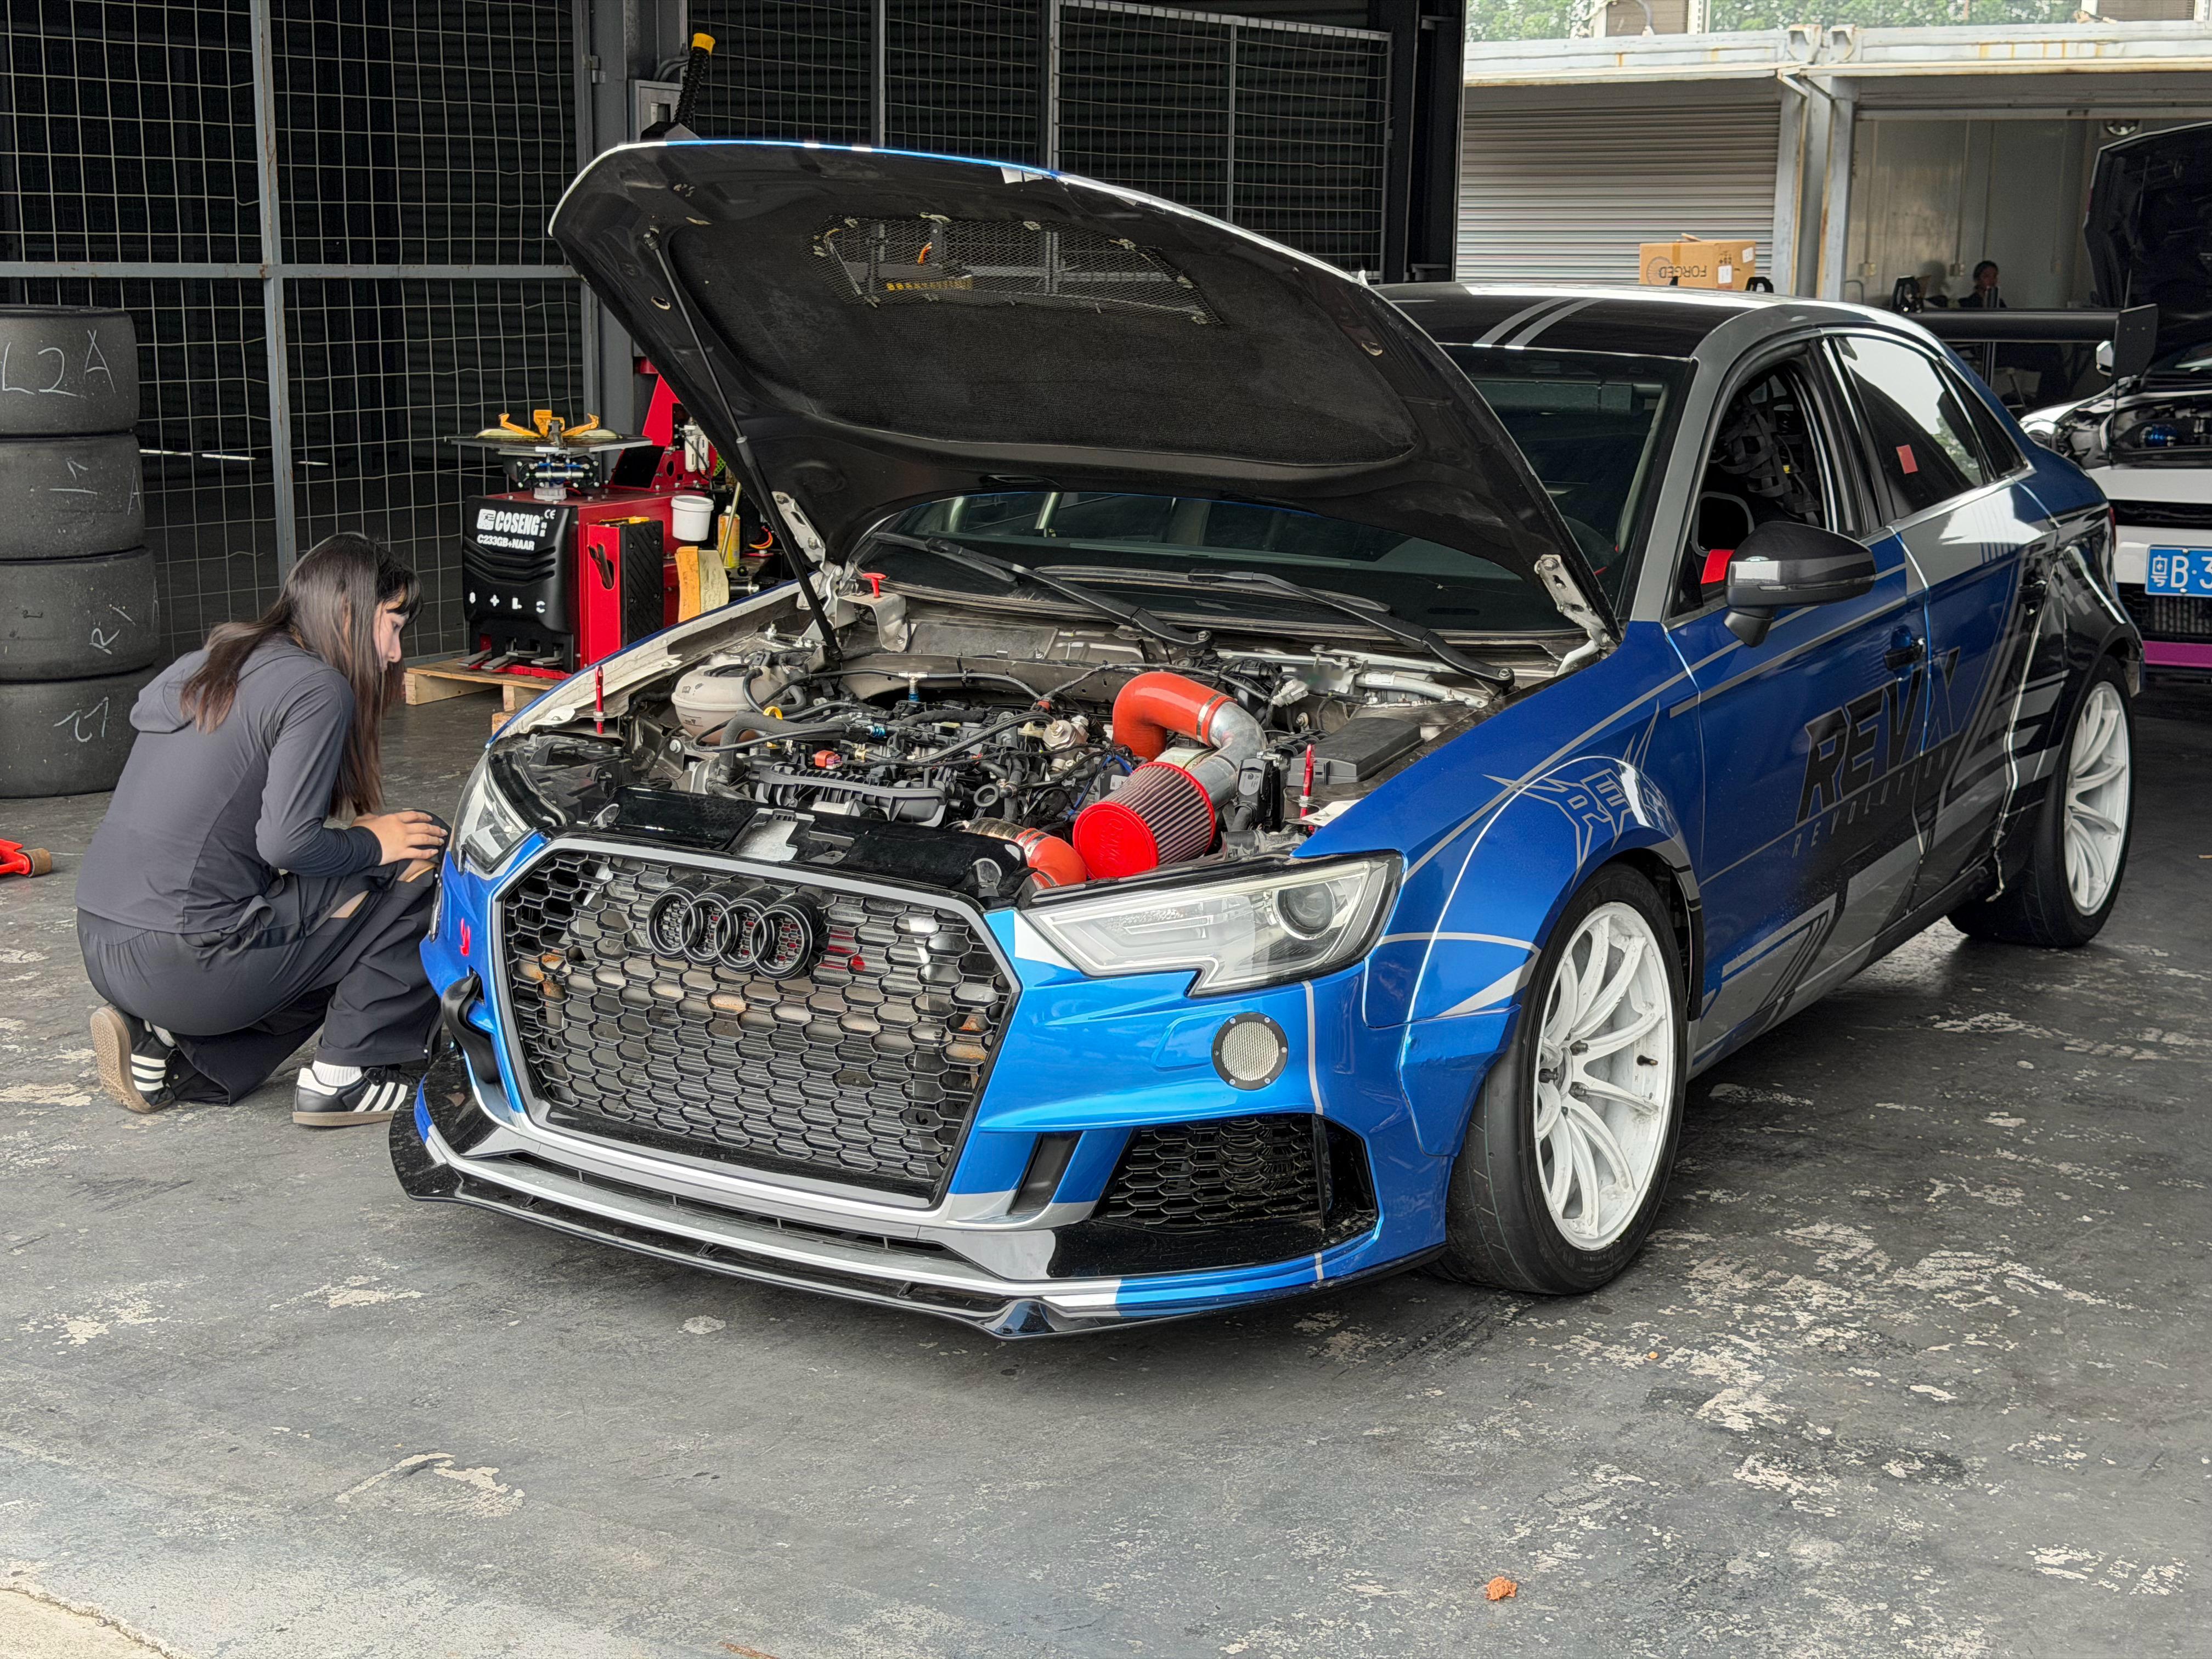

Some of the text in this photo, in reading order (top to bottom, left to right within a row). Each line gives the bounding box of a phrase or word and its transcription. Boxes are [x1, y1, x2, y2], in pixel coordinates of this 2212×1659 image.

[1660, 266, 1707, 278] FORGED
[495, 511, 540, 535] COSENG
[1792, 747, 1948, 859] REVOLUTION
